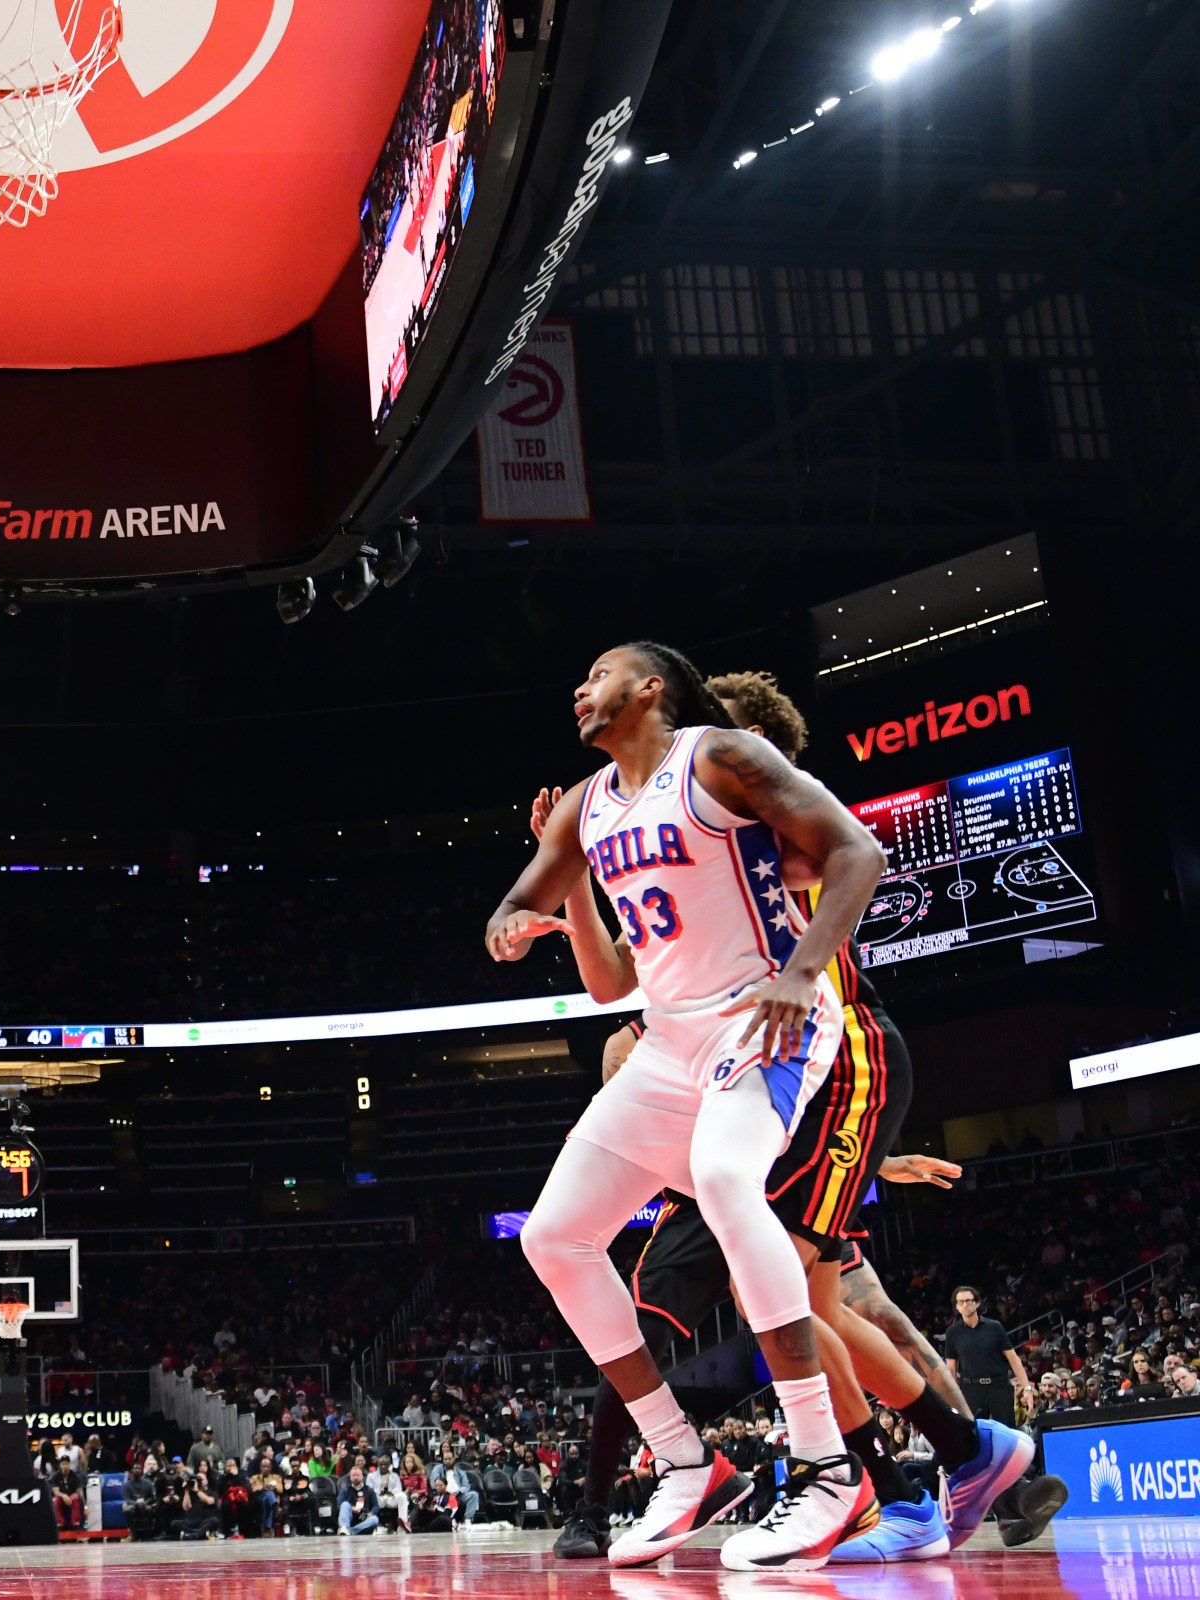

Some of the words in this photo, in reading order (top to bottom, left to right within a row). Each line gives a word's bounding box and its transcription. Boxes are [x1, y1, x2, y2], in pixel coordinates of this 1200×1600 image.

[532, 331, 566, 343] AWKS
[515, 438, 546, 457] TED
[501, 461, 566, 481] TURNER
[99, 501, 226, 539] ARENA
[846, 683, 1032, 762] verizon
[967, 764, 1023, 786] PHILADELPHIA
[1024, 757, 1050, 771] 76ERS
[1009, 776, 1020, 785] PTS
[1021, 772, 1033, 782] REB
[1034, 769, 1045, 779] AST
[1046, 766, 1058, 776] STL
[1059, 762, 1071, 772] FLS
[953, 810, 962, 819] 20
[964, 803, 992, 816] McCain
[1014, 795, 1020, 803] 0
[1027, 792, 1032, 800] 1
[1040, 788, 1045, 797] 2
[1052, 785, 1058, 793] 0
[1065, 782, 1070, 790] 1
[956, 800, 960, 808] 1
[963, 788, 1005, 807] Drummond
[1013, 785, 1019, 794] 2
[1026, 782, 1031, 790] 4
[1038, 779, 1044, 787] 2
[1063, 772, 1068, 780] 1
[859, 800, 893, 815] ATLANTA
[892, 792, 921, 806] HAWKS
[890, 808, 901, 816] PTS
[902, 804, 913, 813] REB
[913, 801, 924, 810] AST
[925, 798, 936, 807] STL
[936, 795, 948, 804] FLS
[965, 813, 992, 825] Walker
[1016, 804, 1022, 813] 0
[1041, 798, 1047, 806] 0
[1054, 795, 1059, 803] 0
[1066, 791, 1072, 800] 0
[894, 816, 900, 825] 2
[906, 813, 910, 821] 1
[917, 810, 922, 818] 1
[928, 807, 934, 815] 0
[895, 825, 901, 834] 0
[918, 820, 924, 828] 0
[930, 817, 935, 825] 0
[942, 814, 947, 822] 0
[956, 830, 964, 838] 77
[967, 819, 1009, 835] Edgecombe
[1030, 811, 1036, 819] 2
[1042, 808, 1048, 816] 0
[1055, 804, 1061, 813] 0
[1068, 801, 1074, 810] 2
[908, 832, 913, 840] 7
[920, 829, 925, 837] 1
[932, 826, 936, 834] 1
[943, 823, 948, 831] 1
[968, 832, 995, 845] George
[1017, 823, 1027, 832] 17
[1031, 820, 1037, 829] 0
[1056, 814, 1062, 823] 0
[1069, 811, 1075, 819] 0
[586, 823, 696, 884] PHILA
[898, 844, 903, 852] 7
[921, 838, 926, 846] 1
[933, 835, 938, 843] 1
[944, 832, 950, 840] 0
[899, 853, 904, 861] 7
[922, 848, 928, 856] 2
[934, 845, 939, 853] 0
[946, 842, 951, 850] 2
[959, 848, 972, 858] 2PT
[1021, 833, 1033, 843] 3PT
[900, 862, 912, 872] 3PT
[617, 886, 683, 950] 33
[27, 1030, 52, 1045] 40
[114, 1028, 127, 1037] FLS
[327, 1021, 364, 1031] georgia
[114, 1037, 129, 1045] TOL
[10, 1168, 29, 1197] 7
[1129, 1459, 1200, 1501] KAISER
